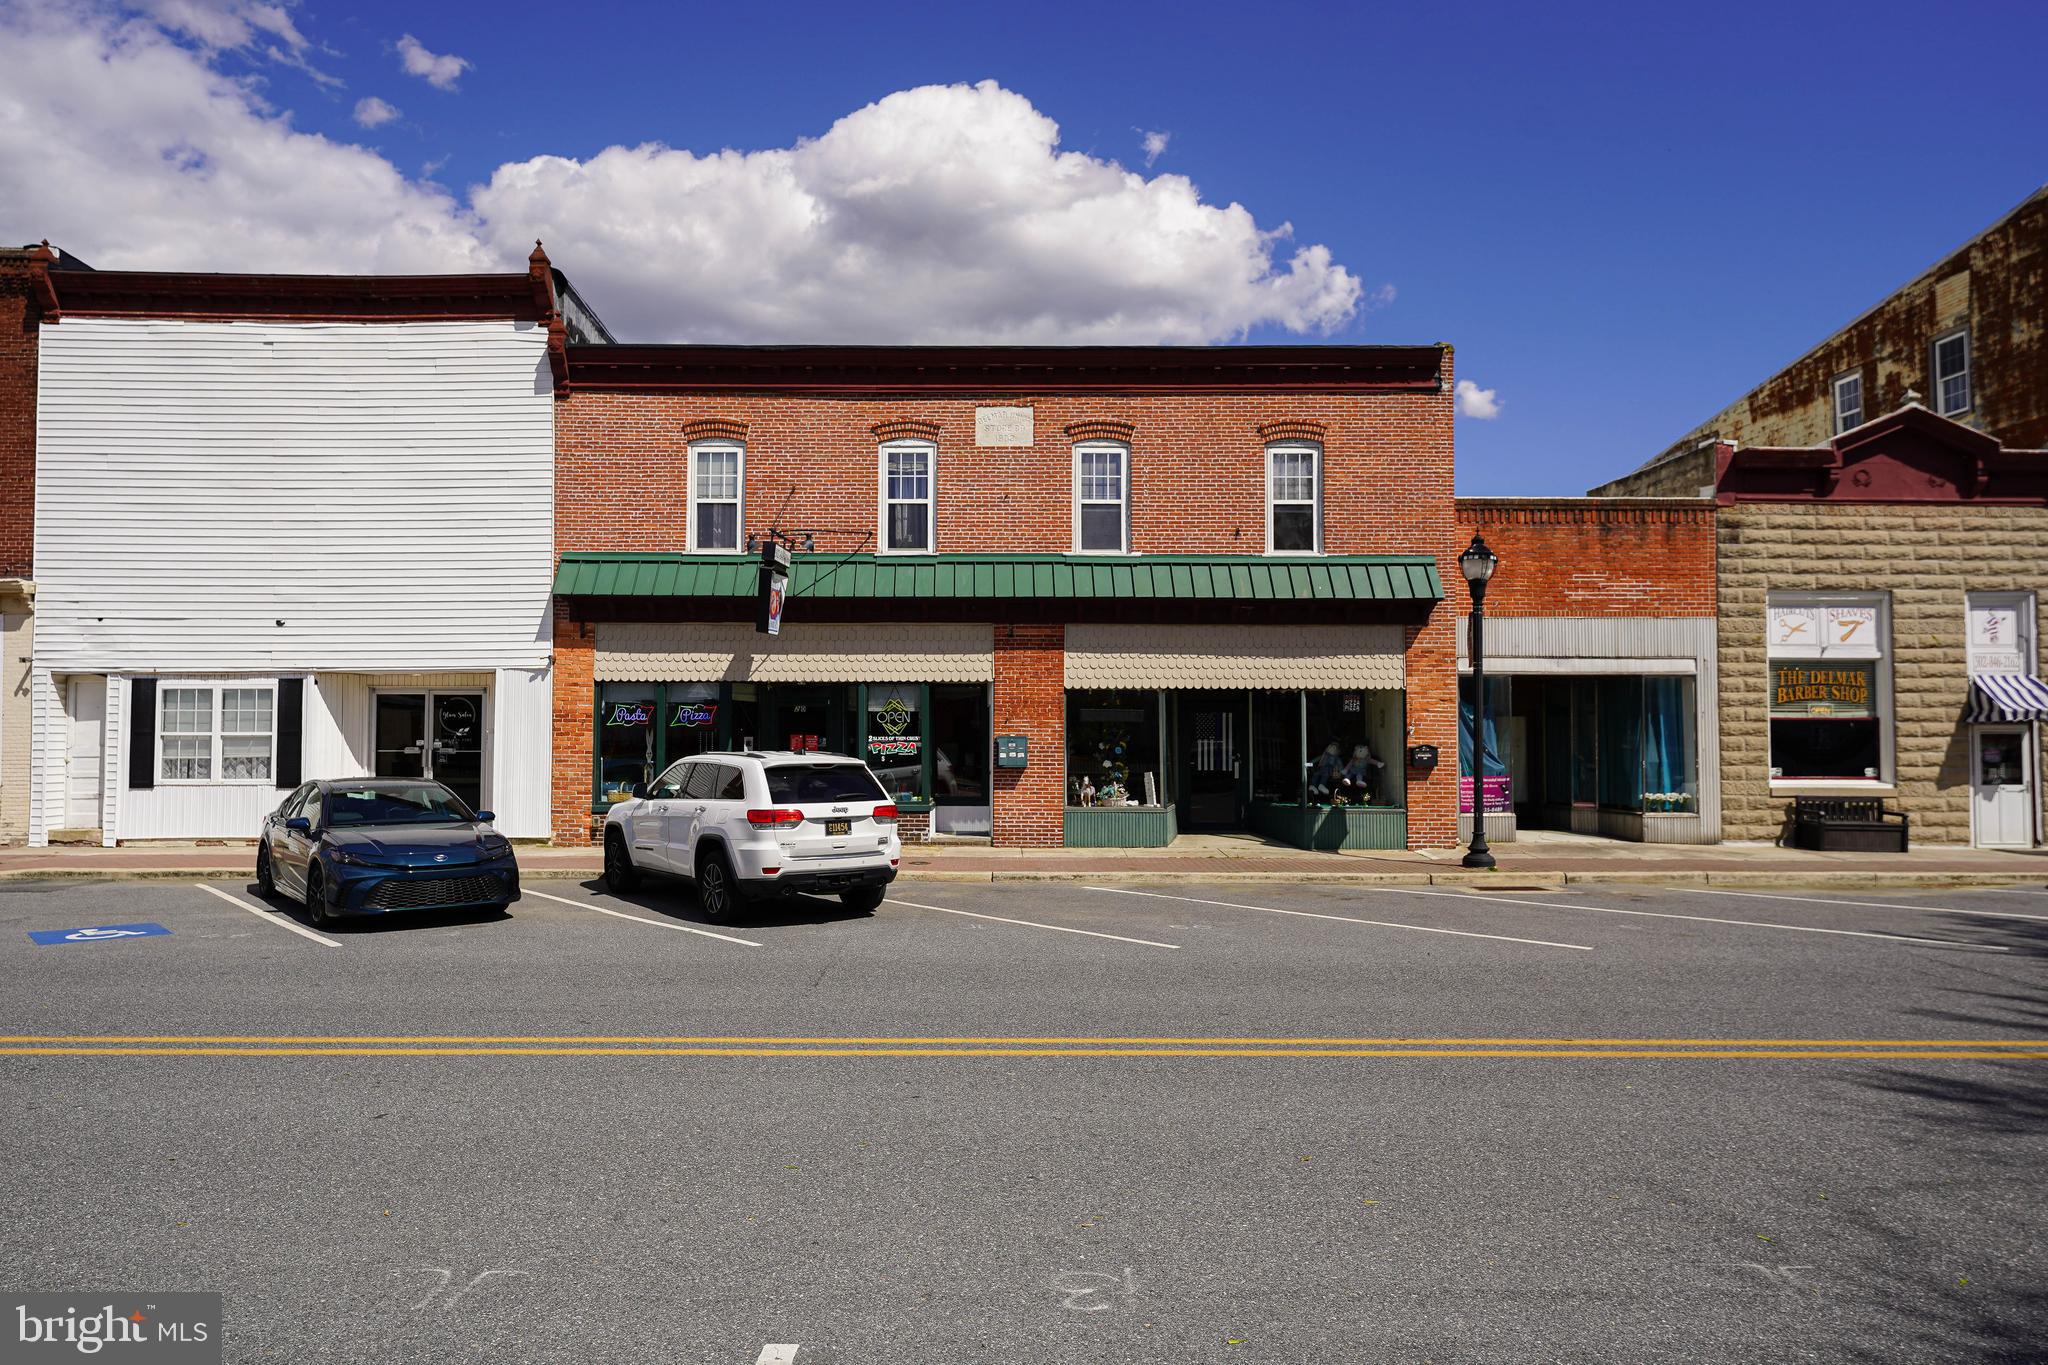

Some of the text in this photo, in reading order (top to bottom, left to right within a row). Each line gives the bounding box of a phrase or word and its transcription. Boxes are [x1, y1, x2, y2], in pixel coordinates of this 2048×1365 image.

[1829, 608, 1873, 622] SHAVES
[1777, 671, 1867, 687] THE DELMAR
[1777, 685, 1869, 704] BARBER SHOP
[616, 707, 648, 722] Pasta
[680, 708, 711, 722] Pizza
[877, 711, 910, 723] OPEN
[871, 742, 918, 755] PIZZA
[832, 806, 849, 814] Jeep
